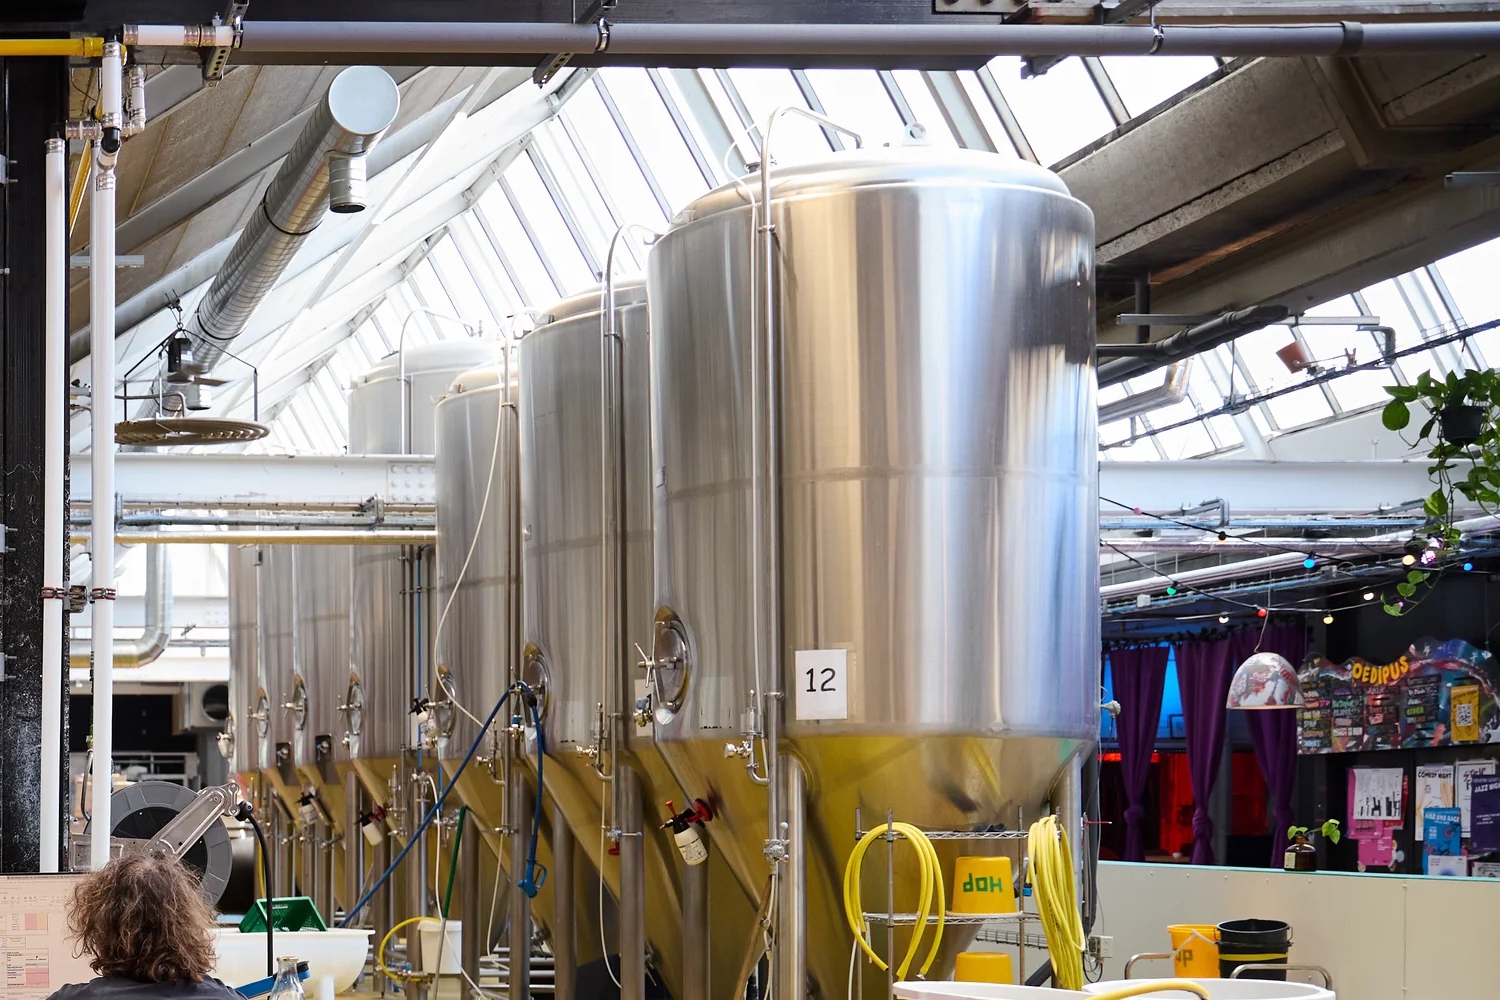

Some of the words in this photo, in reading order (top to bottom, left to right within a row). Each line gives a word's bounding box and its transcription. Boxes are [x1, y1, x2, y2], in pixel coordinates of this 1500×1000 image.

[806, 667, 836, 692] 12
[1352, 656, 1409, 685] OEDIPUS
[1474, 784, 1489, 793] JAZZ
